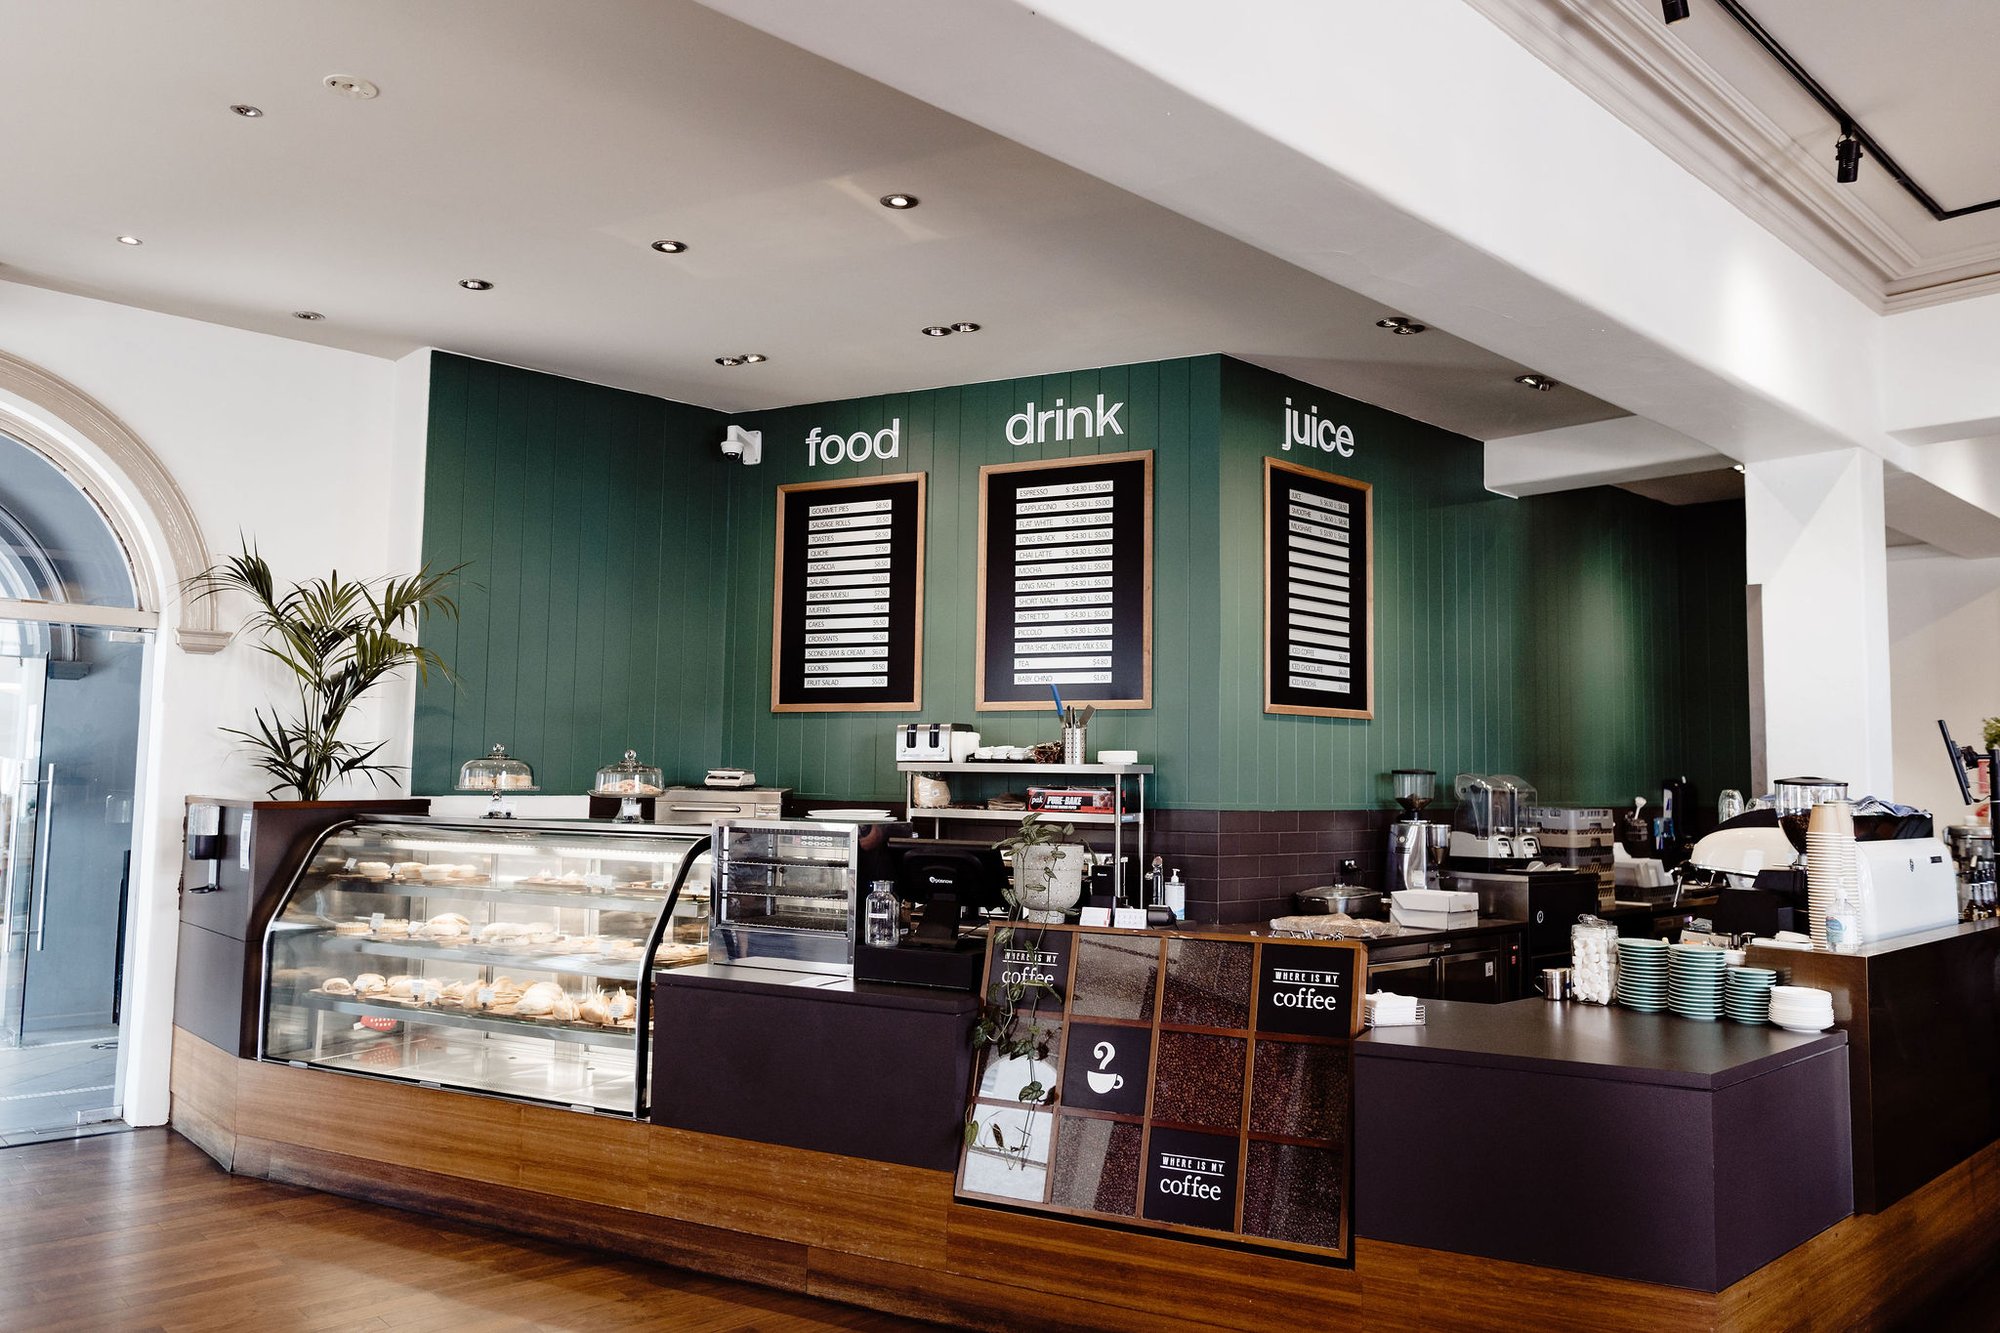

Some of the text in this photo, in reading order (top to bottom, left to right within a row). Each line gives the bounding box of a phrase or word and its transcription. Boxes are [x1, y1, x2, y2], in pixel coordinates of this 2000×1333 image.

[1006, 394, 1124, 445] drink
[1282, 397, 1354, 457] juice
[805, 418, 899, 466] food
[1019, 488, 1048, 497] ESPRESSO
[1291, 492, 1301, 500] JUICE
[811, 506, 837, 515] GOURMET
[1031, 795, 1043, 805] pak
[1004, 952, 1030, 961] WHERE
[1046, 955, 1057, 963] MY
[1001, 966, 1054, 987] coffee
[1275, 971, 1338, 984] WHERE IS MY
[1273, 987, 1336, 1011] coffee
[1162, 1156, 1223, 1173] WHERE IS MY
[1160, 1174, 1221, 1201] coffee
